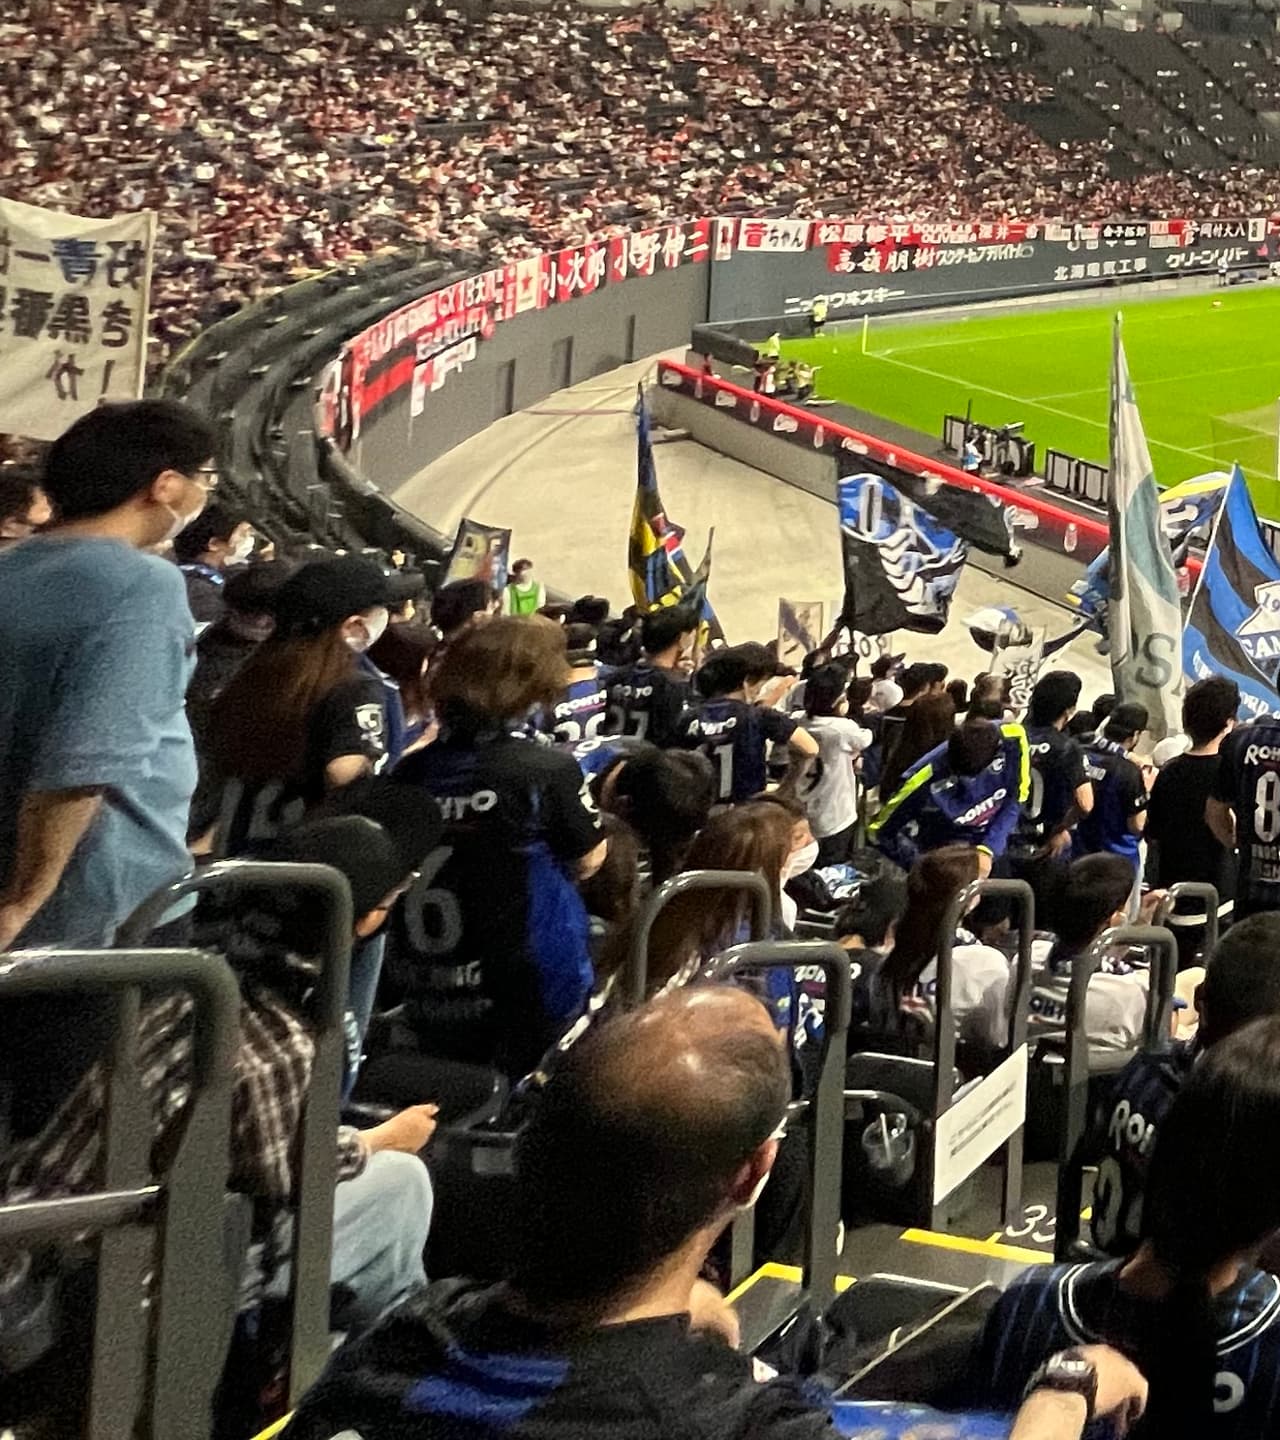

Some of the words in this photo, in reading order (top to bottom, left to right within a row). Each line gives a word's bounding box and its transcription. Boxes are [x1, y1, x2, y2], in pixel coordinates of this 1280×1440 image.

[744, 222, 804, 249] 菅ちゃん
[818, 223, 912, 244] 松原修平
[613, 229, 709, 278] 小野伸二
[541, 246, 606, 300] 小次郎
